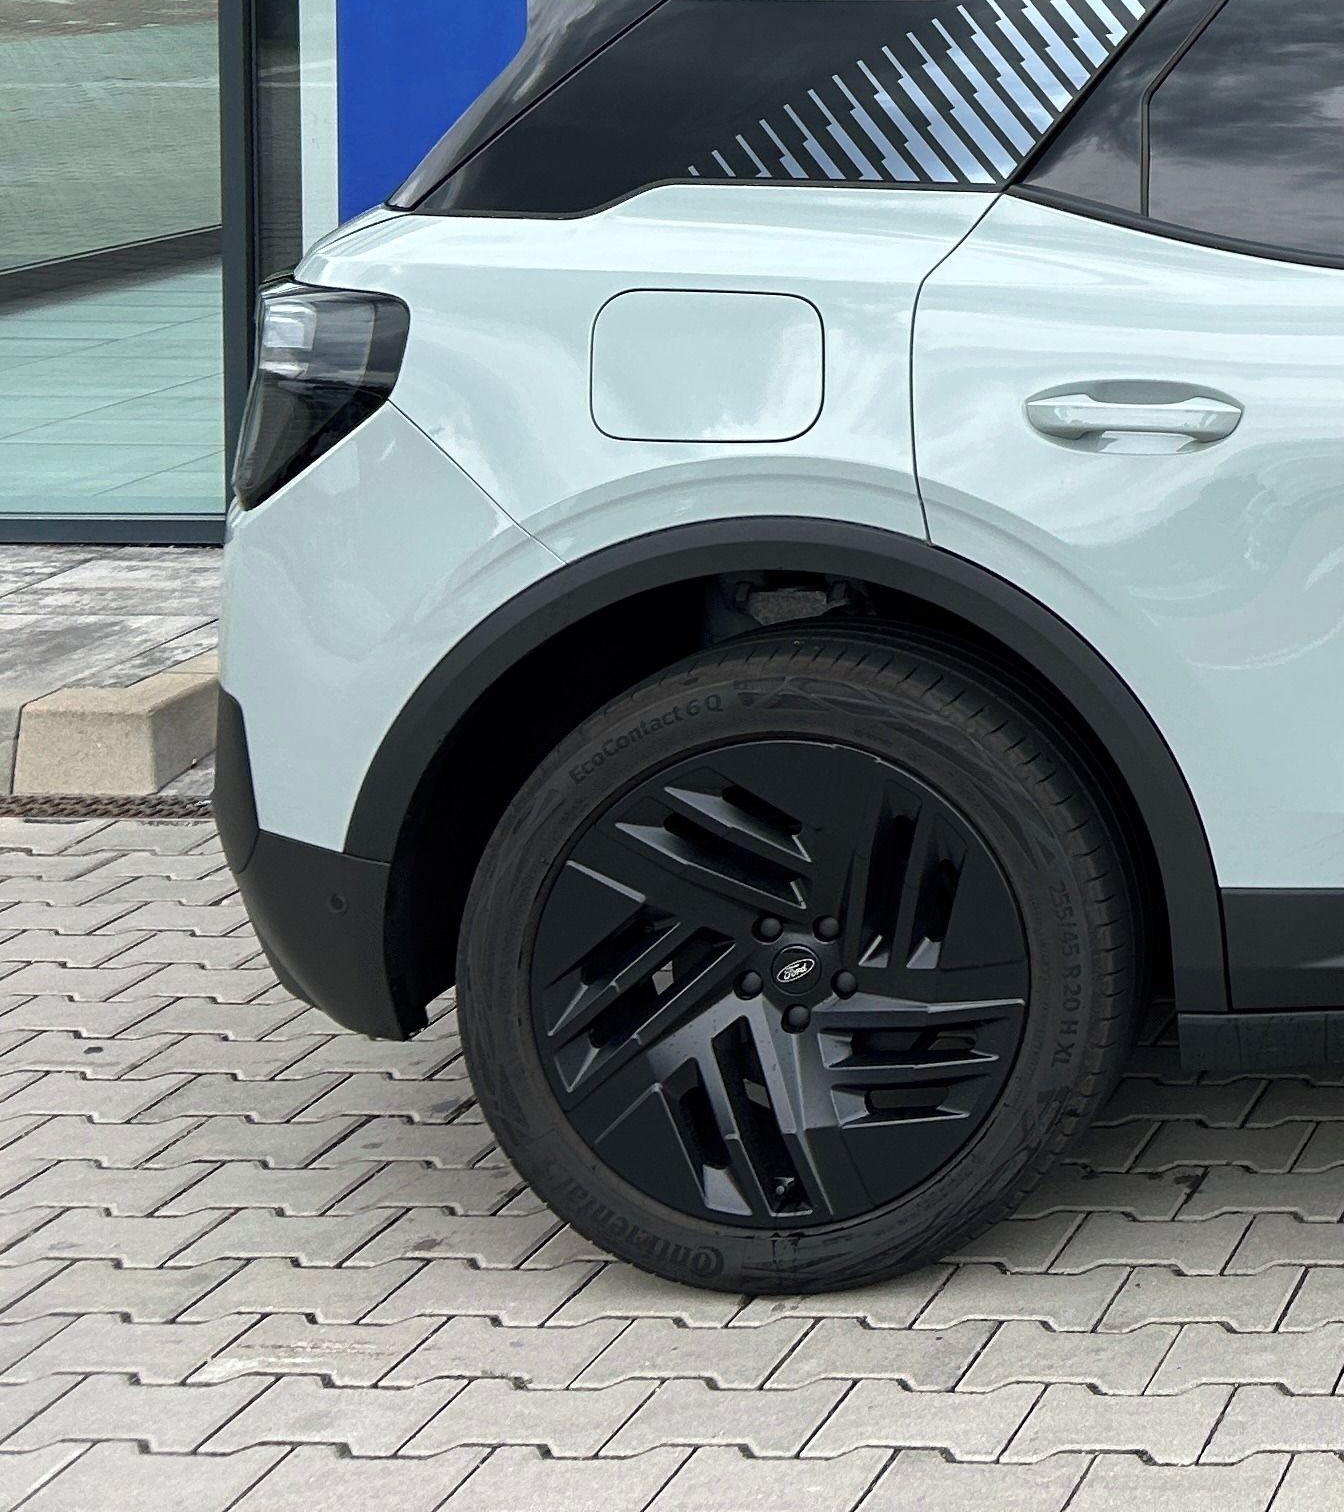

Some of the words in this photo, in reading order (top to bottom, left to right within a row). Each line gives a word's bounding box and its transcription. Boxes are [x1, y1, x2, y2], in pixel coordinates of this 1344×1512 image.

[570, 702, 684, 784] EcoContact
[1048, 879, 1081, 958] 255/45
[783, 962, 807, 980] Ford
